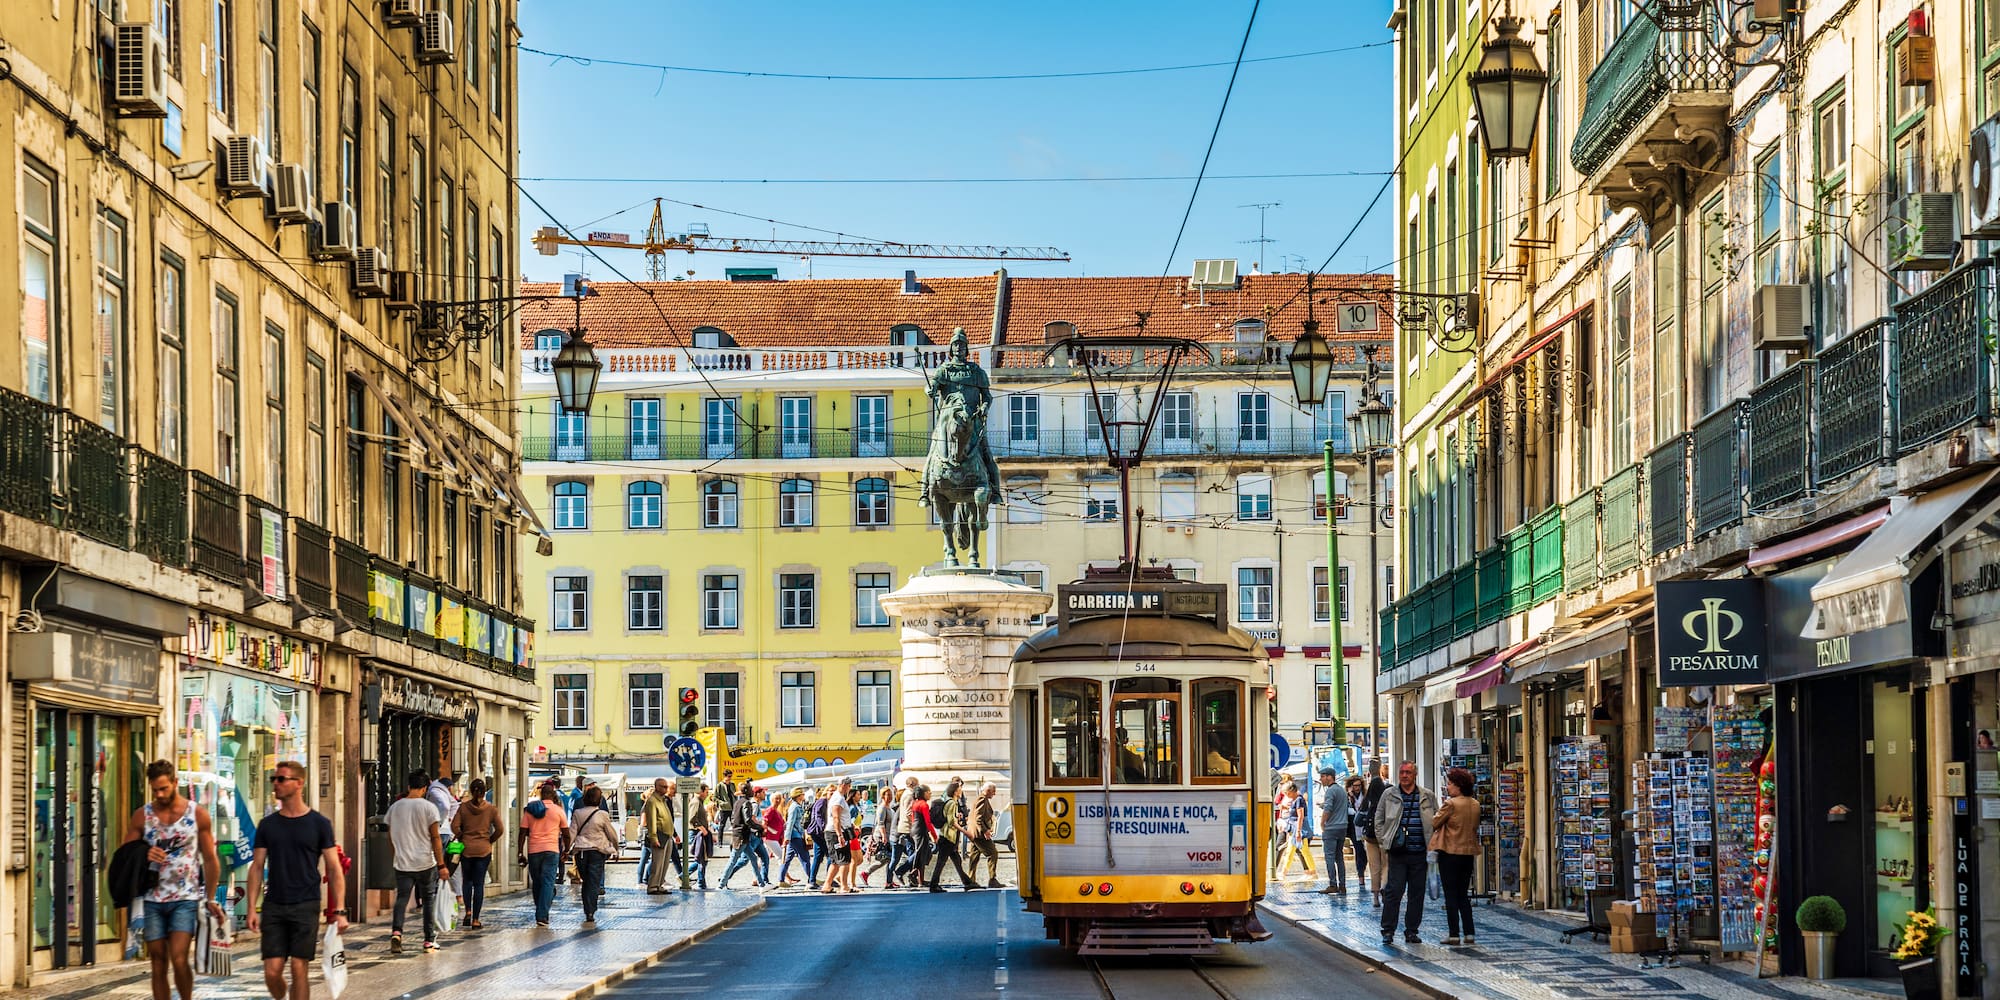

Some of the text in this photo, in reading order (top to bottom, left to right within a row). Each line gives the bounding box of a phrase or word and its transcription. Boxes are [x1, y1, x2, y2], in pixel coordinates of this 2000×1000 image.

[1347, 305, 1366, 323] 10
[1068, 594, 1159, 609] CARREIRA Nº
[996, 617, 1009, 625] REI
[1013, 617, 1021, 626] DE
[1816, 635, 1851, 668] PESARUM
[1135, 662, 1156, 672] 544
[1669, 655, 1759, 671] PESARUM
[935, 693, 958, 704] DOM
[965, 691, 995, 703] JOÃO
[999, 693, 1003, 702] I
[1790, 696, 1796, 712] 6
[932, 711, 960, 720] CIDADE
[739, 760, 753, 768] city
[1078, 805, 1218, 822] LISBOA MENINA E MOÇA,
[1109, 821, 1190, 835] FRESQUINHA.
[1186, 851, 1223, 862] VIGOR
[1957, 836, 1970, 976] LUA DE PRATA
